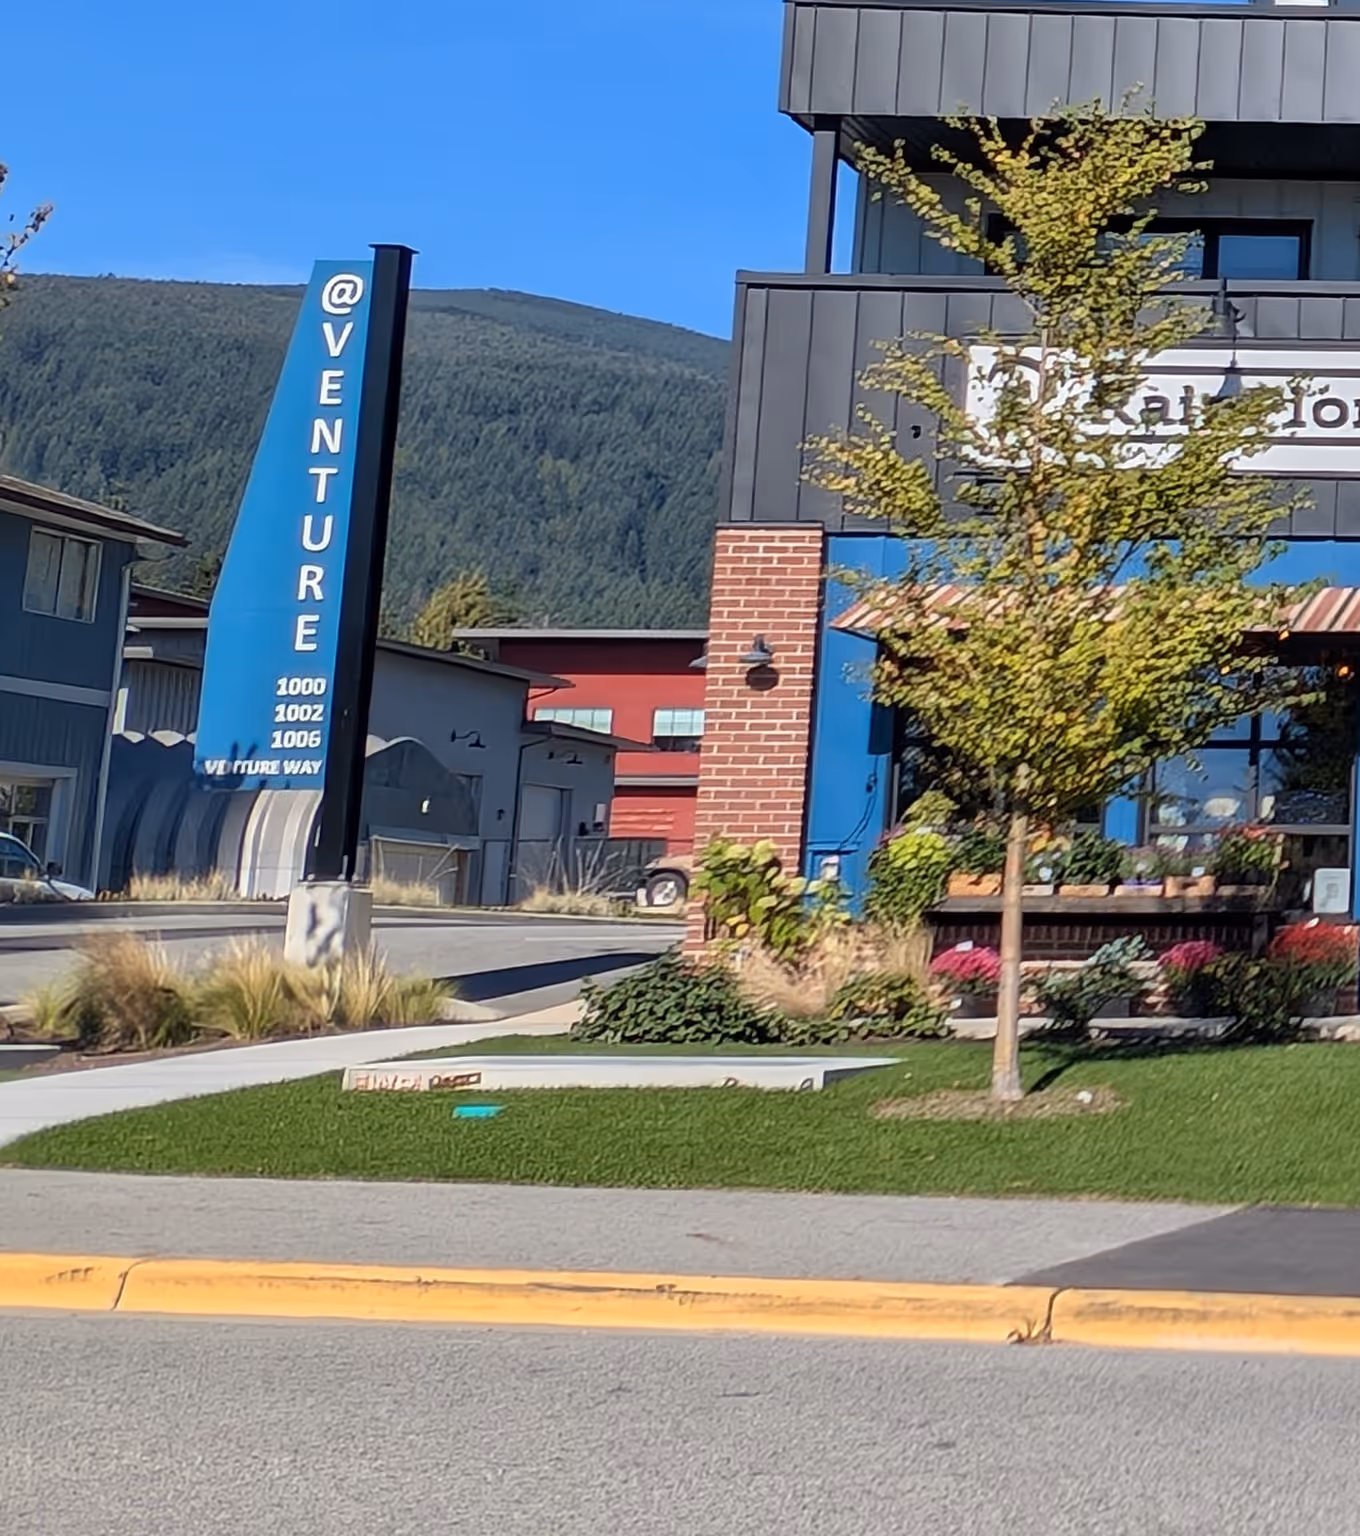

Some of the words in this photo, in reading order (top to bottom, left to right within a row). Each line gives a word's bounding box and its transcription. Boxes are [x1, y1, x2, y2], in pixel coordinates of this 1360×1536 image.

[277, 677, 327, 696] 1000
[274, 703, 325, 722] 1002
[271, 730, 321, 749] 1006
[283, 759, 322, 775] WAY
